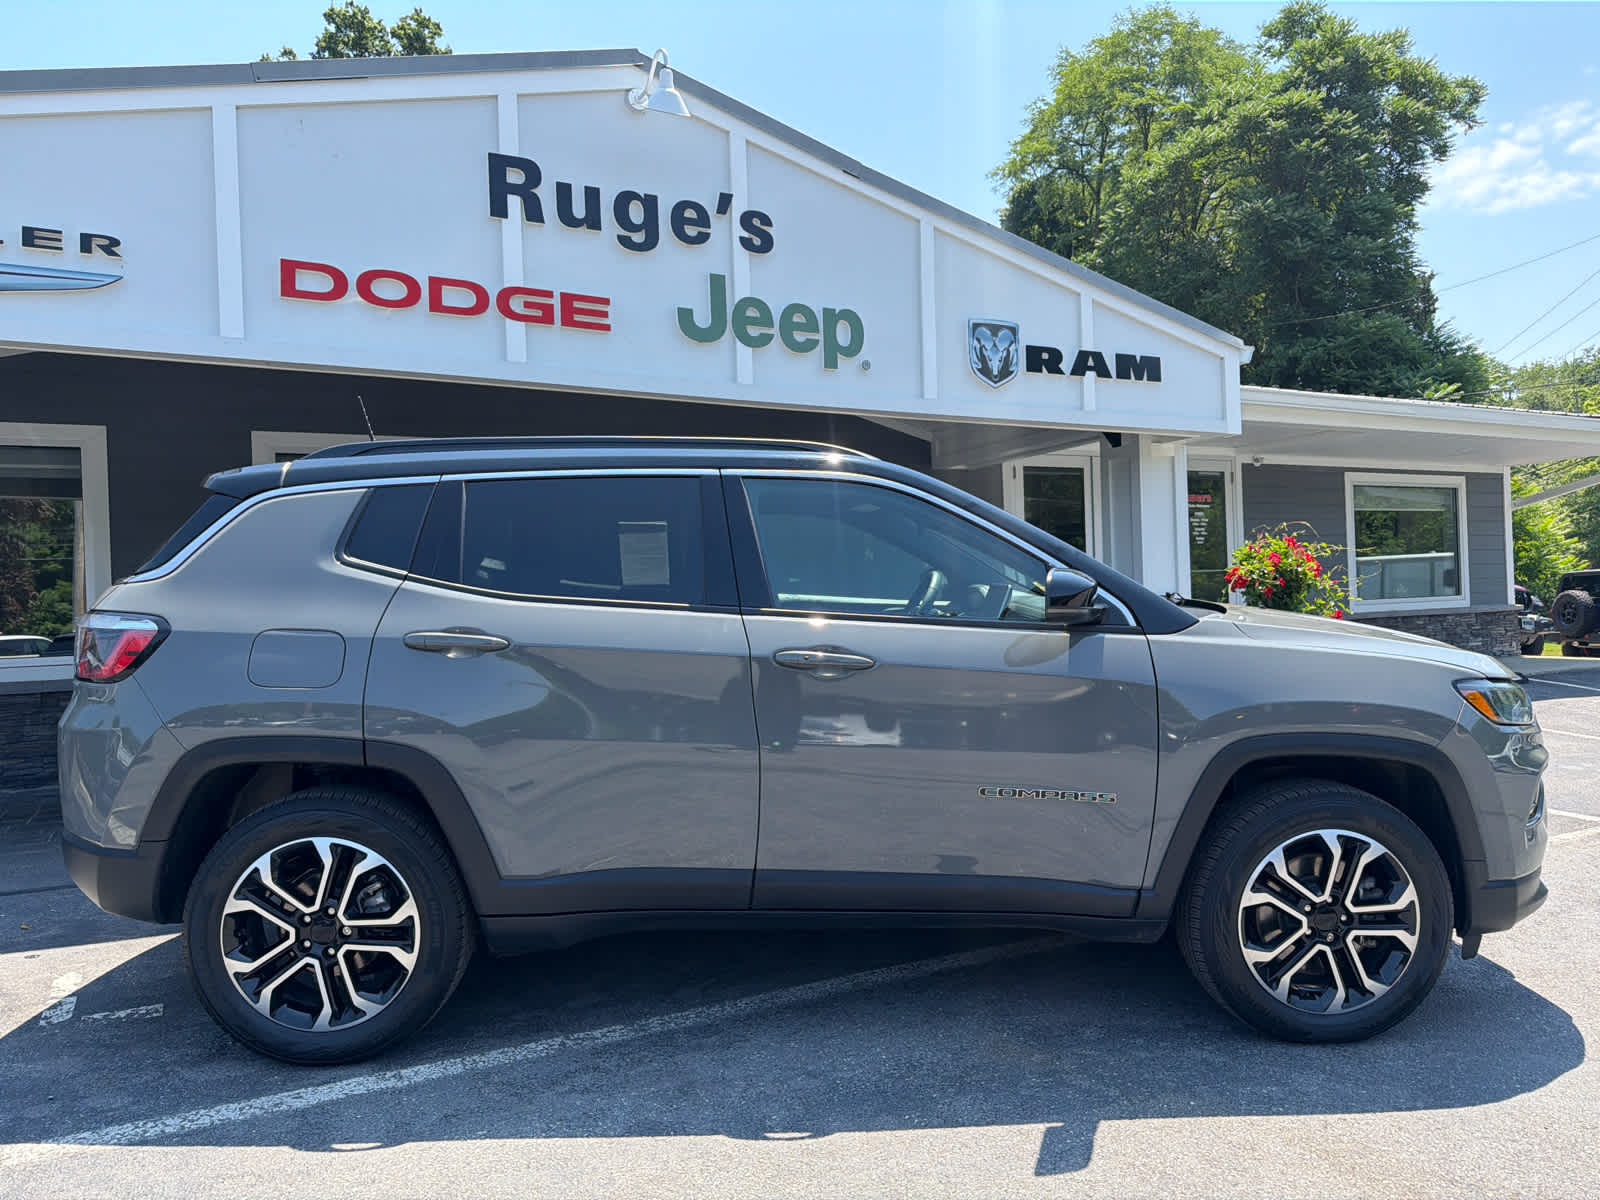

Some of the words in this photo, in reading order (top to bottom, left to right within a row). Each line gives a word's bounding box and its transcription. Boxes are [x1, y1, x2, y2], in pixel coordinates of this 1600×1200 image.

[487, 151, 774, 254] Ruge's
[0, 225, 122, 257] ER
[280, 258, 611, 331] DODGE
[1025, 344, 1162, 383] RAM
[978, 786, 1117, 803] COMPASS
